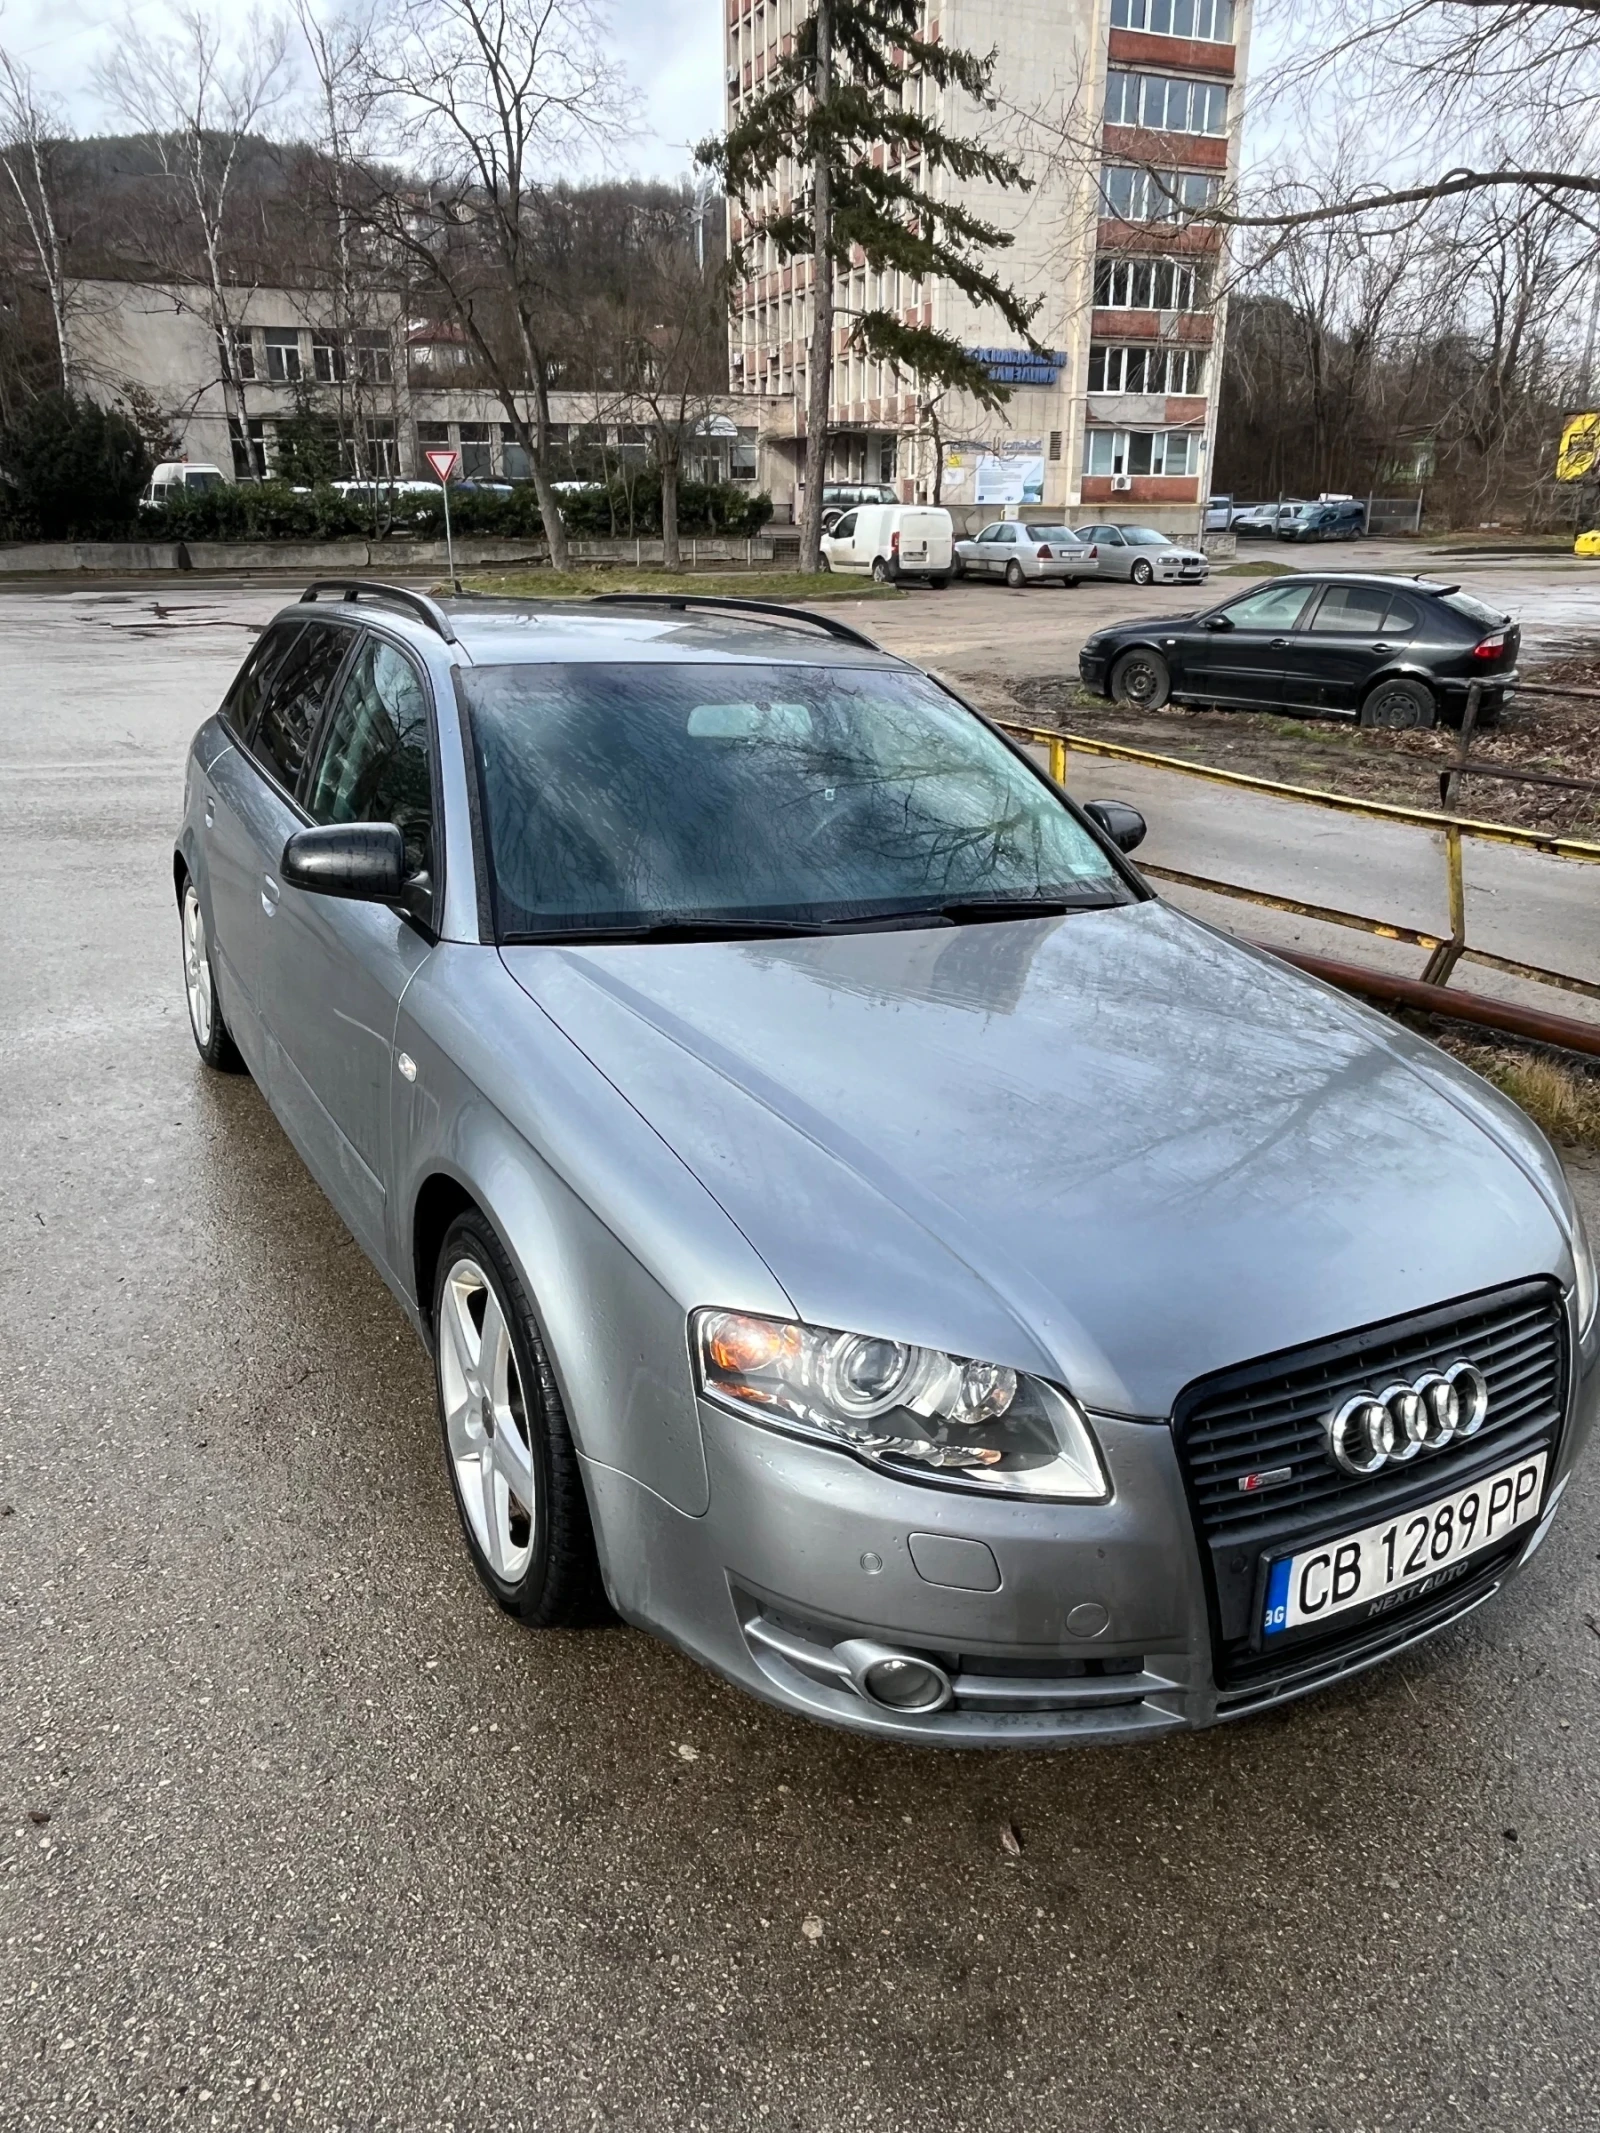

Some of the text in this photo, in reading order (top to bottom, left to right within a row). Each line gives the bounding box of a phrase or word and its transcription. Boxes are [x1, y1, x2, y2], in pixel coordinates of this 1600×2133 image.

[1299, 1465, 1538, 1615] CB 1289 PP
[1264, 1605, 1284, 1627] BG
[1368, 1561, 1469, 1616] NEXT AUTO
